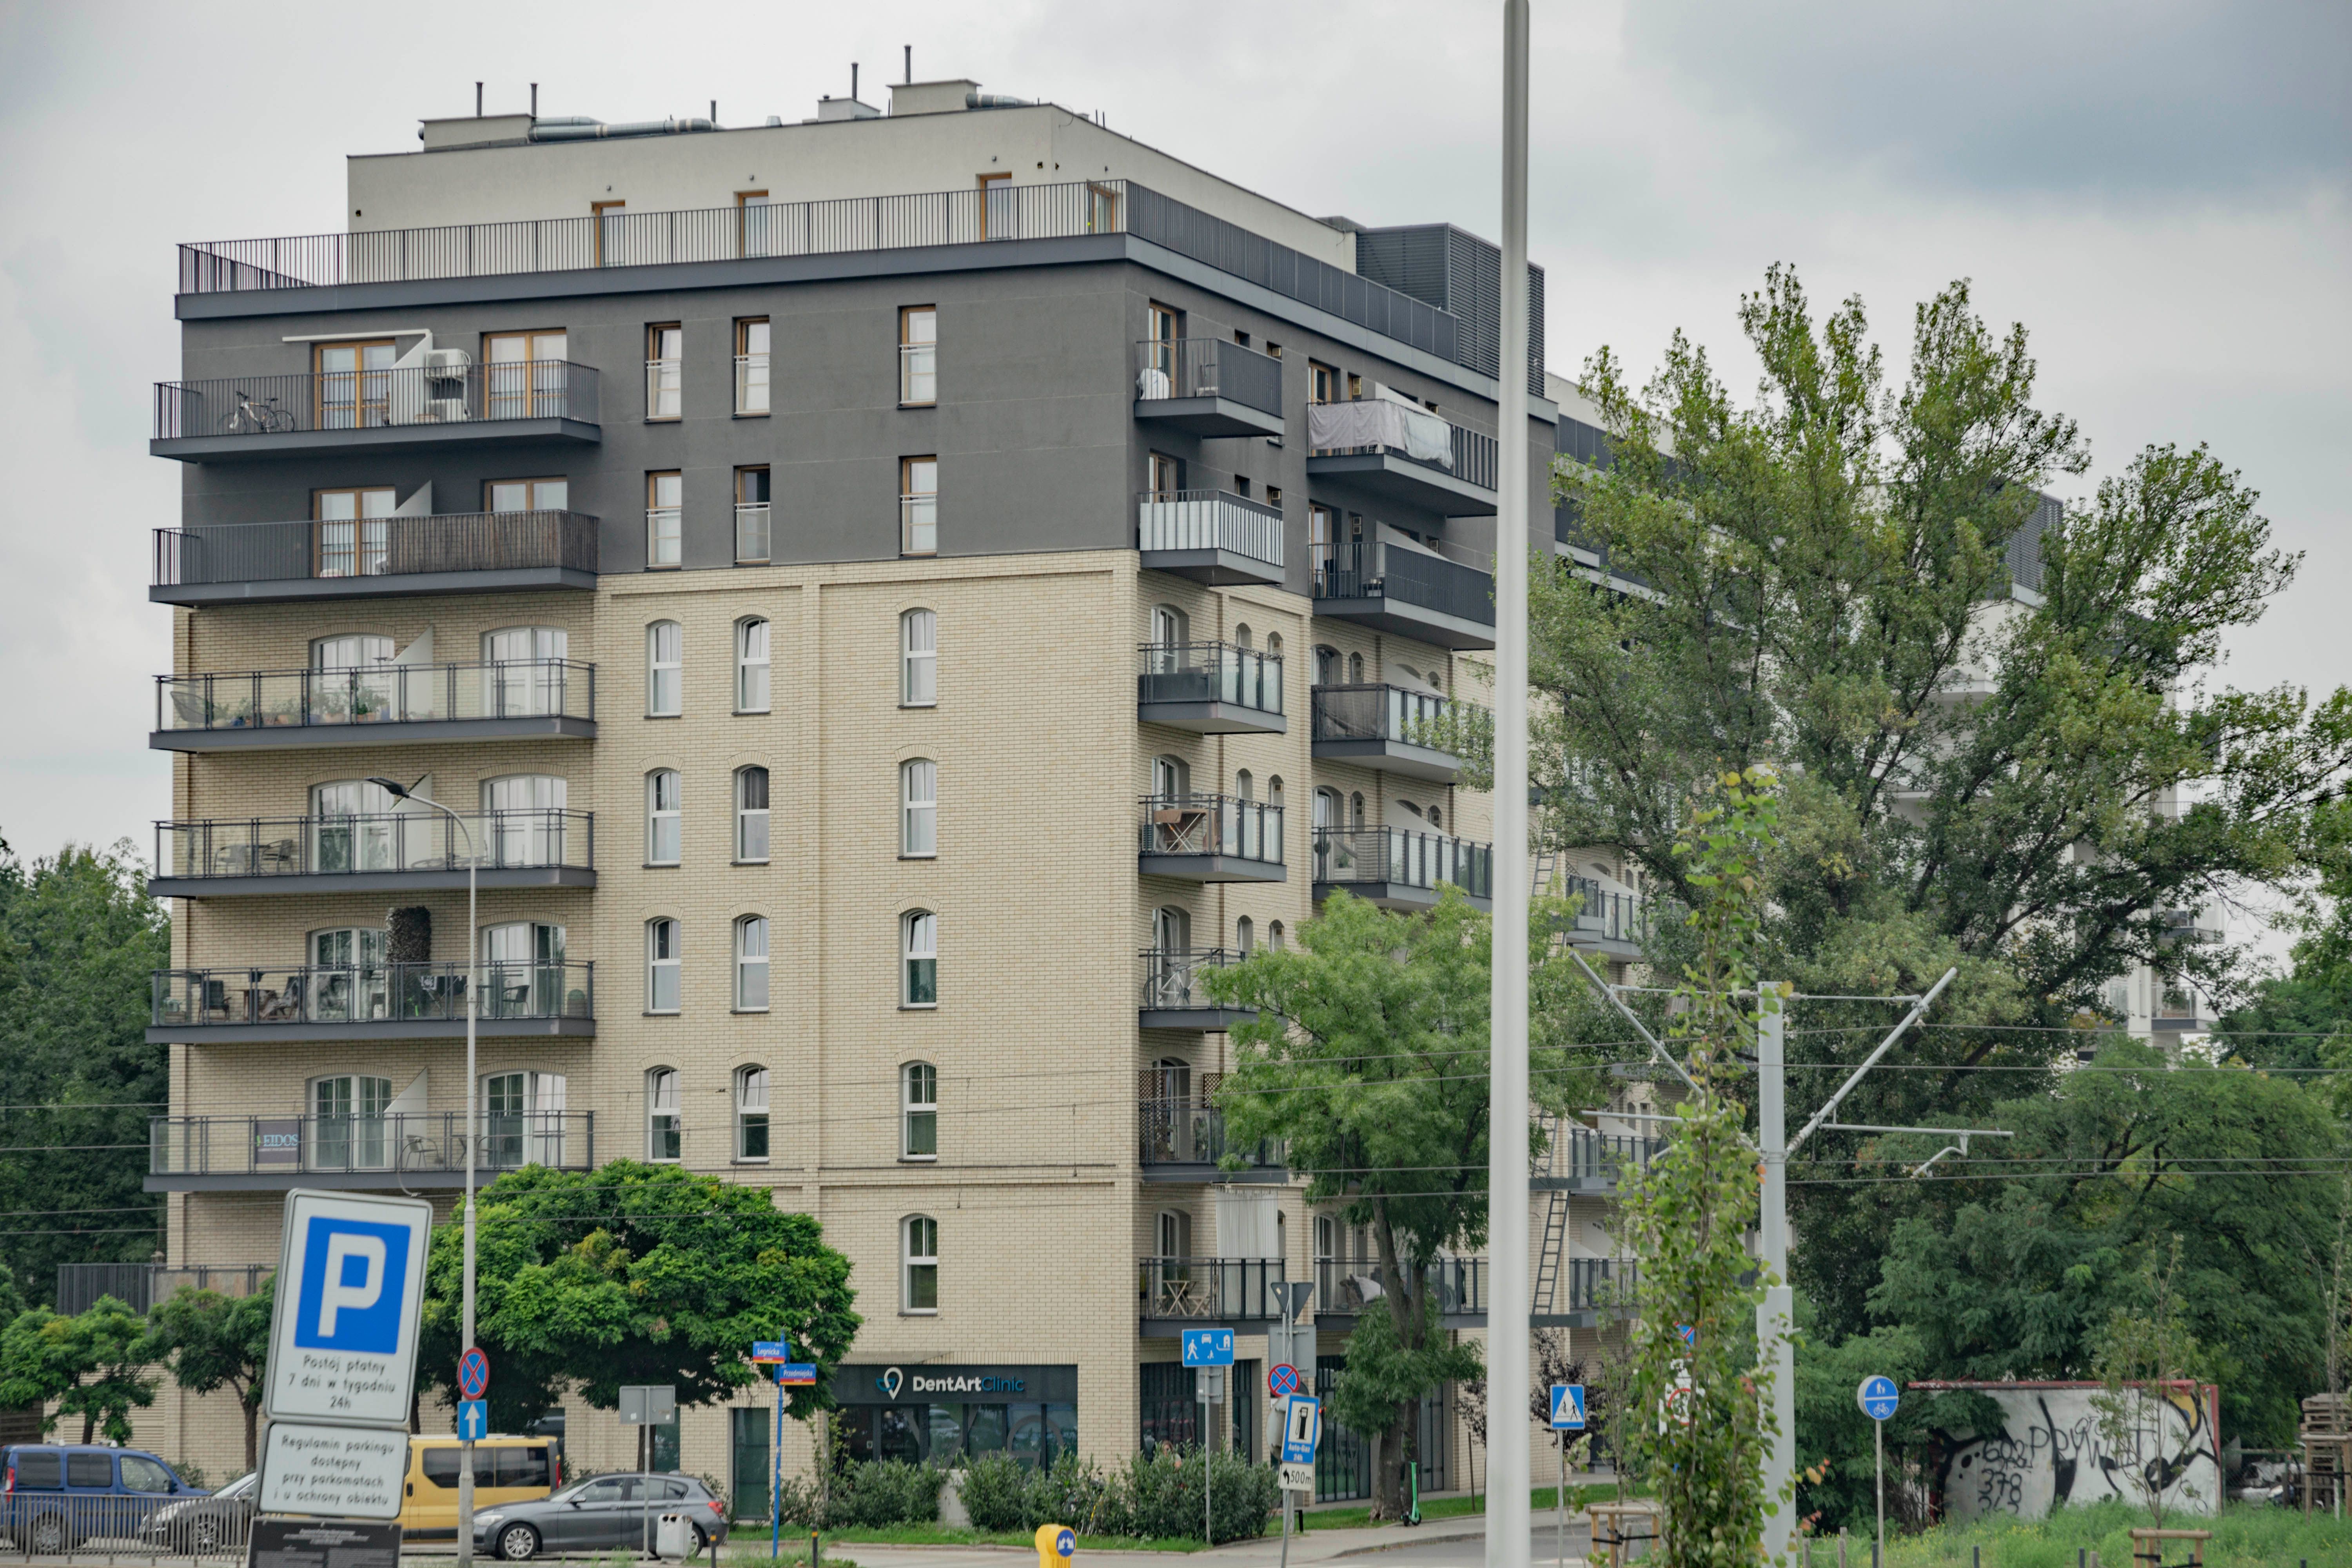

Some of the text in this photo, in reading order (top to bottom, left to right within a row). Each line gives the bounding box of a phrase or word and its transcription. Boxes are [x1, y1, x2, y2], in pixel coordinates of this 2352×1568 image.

[263, 1134, 299, 1147] EIDOS
[318, 1232, 387, 1338] P
[757, 1348, 780, 1356] Legnicka
[303, 1354, 386, 1376] Postój płatny
[783, 1369, 813, 1379] Przedmiejska
[289, 1373, 396, 1394] 7 dni w tygodniu
[329, 1396, 351, 1409] 24h
[281, 1434, 394, 1455] Regulamin parkingu
[1288, 1443, 1310, 1453] Auto-Gaz
[1294, 1453, 1303, 1461] 24h
[283, 1473, 384, 1488] przy parkomatach
[284, 1491, 290, 1500] u
[296, 1490, 341, 1506] ochrony
[346, 1492, 389, 1506] obiektu
